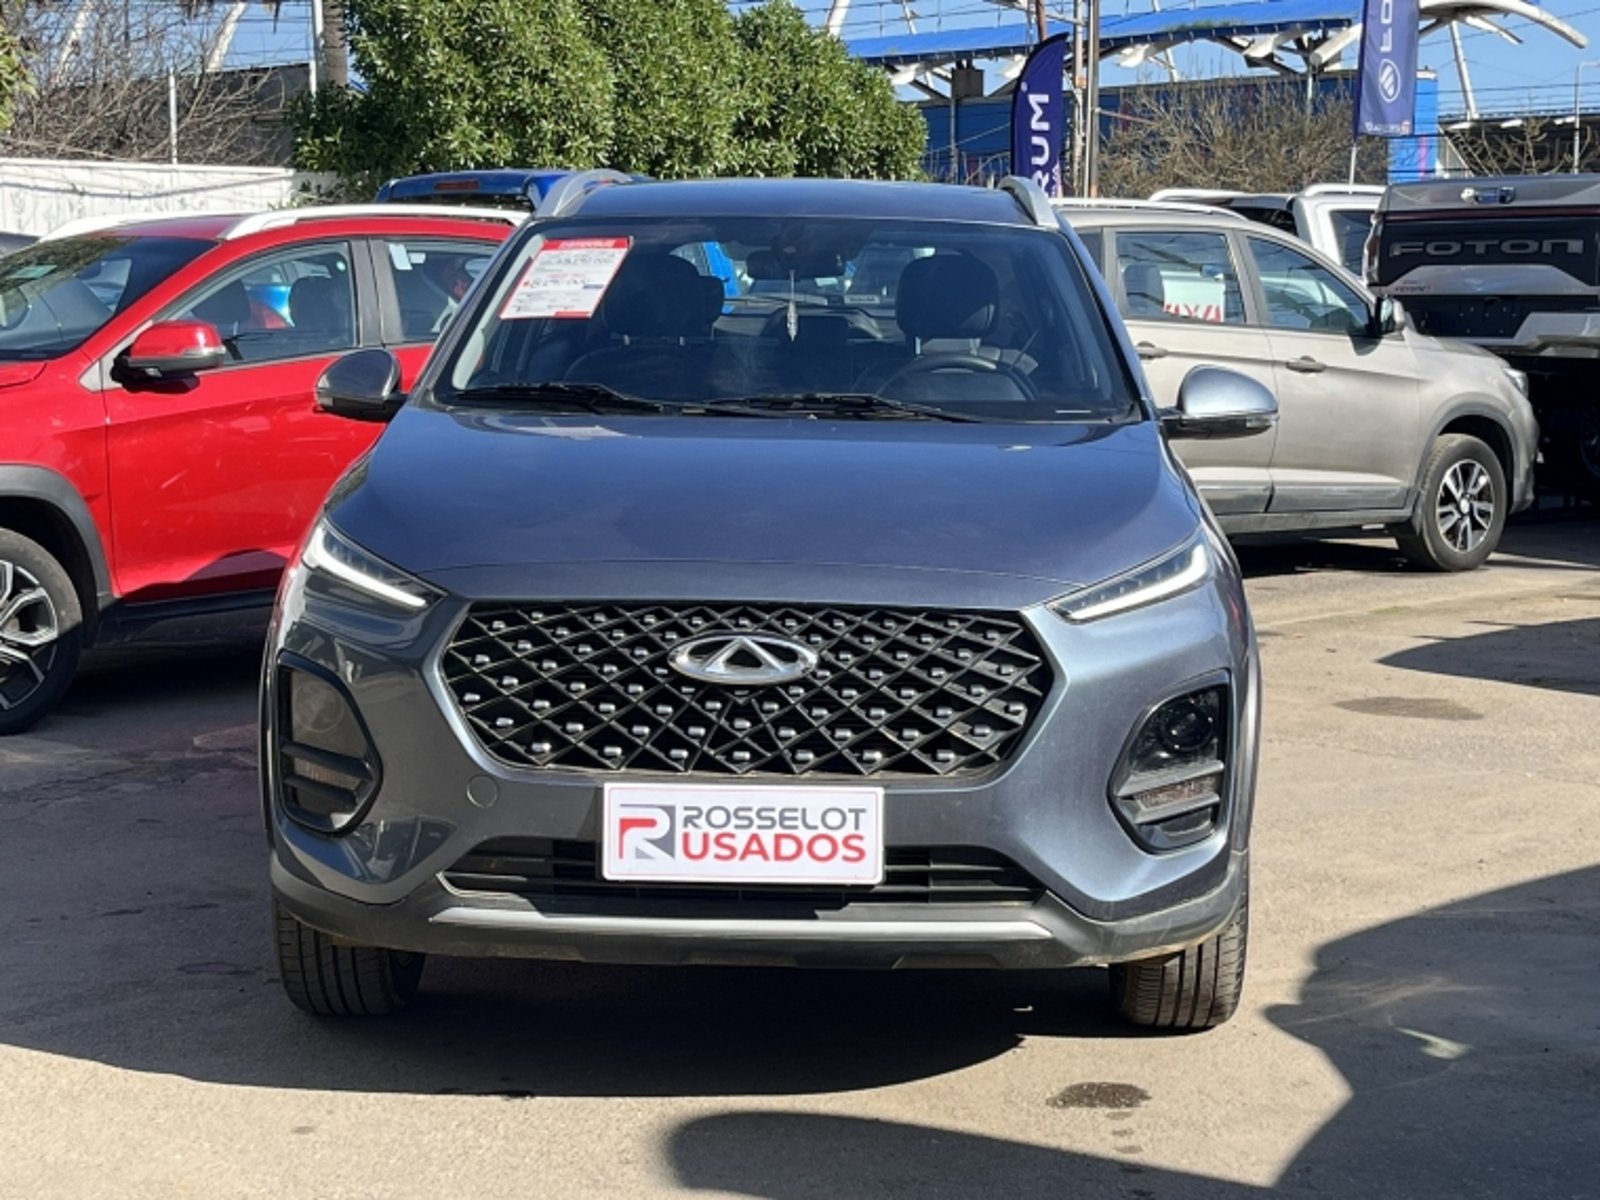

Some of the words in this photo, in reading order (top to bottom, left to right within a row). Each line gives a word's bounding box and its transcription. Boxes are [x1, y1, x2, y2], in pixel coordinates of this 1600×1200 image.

[1389, 239, 1584, 257] FOTON
[683, 805, 867, 831] ROSSELOT
[682, 832, 866, 863] USADOS
